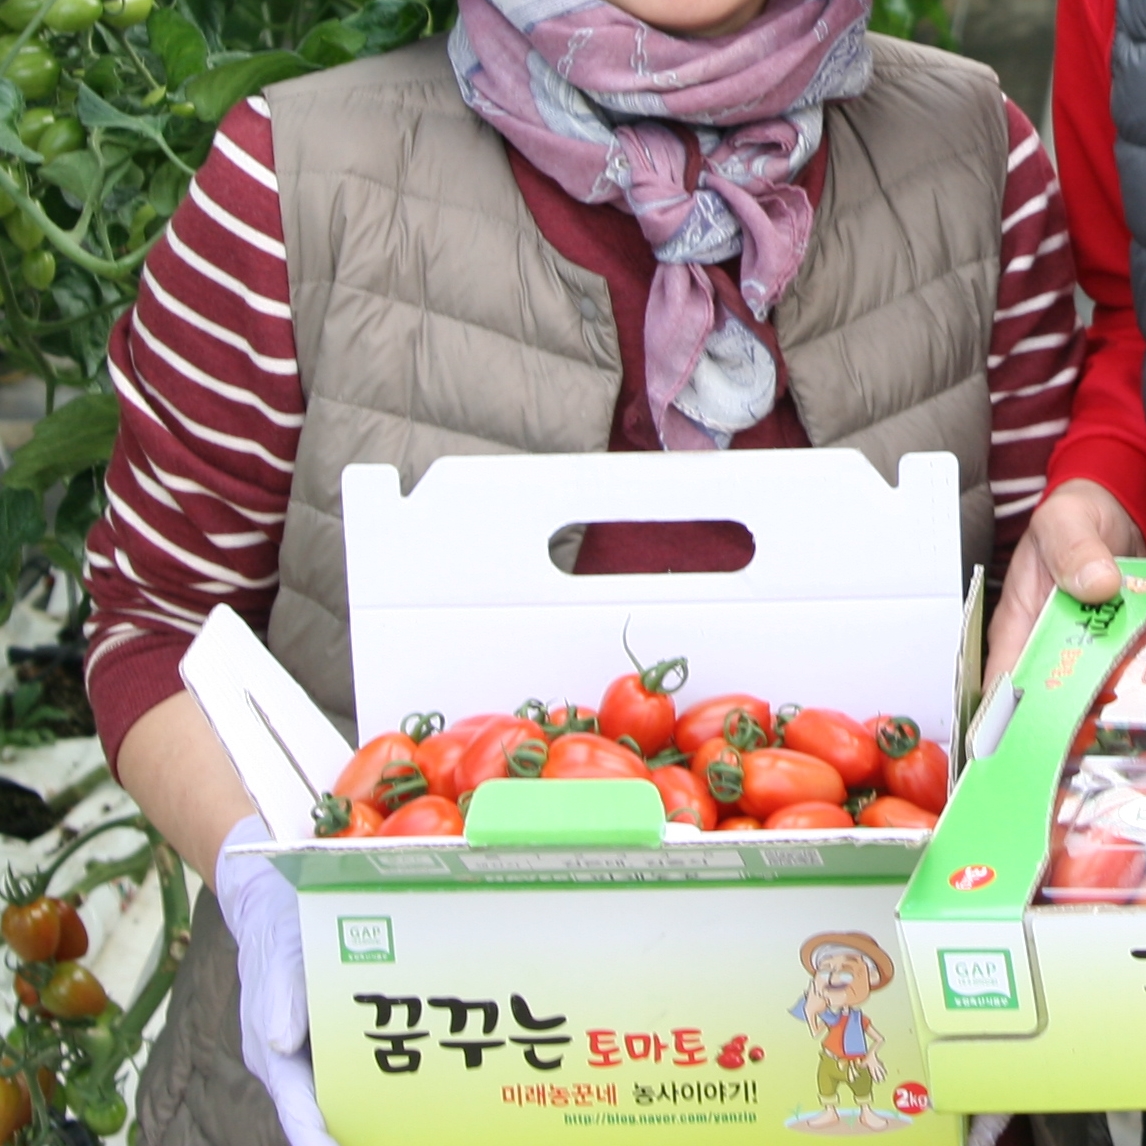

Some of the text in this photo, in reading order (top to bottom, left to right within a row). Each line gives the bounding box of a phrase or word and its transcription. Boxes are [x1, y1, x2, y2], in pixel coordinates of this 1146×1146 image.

[350, 925, 381, 939] GAP
[955, 961, 997, 979] GAP
[353, 992, 708, 1074] 꿈꾸는 토마토
[501, 1080, 759, 1107] 미래농꾼네 농사이야기!
